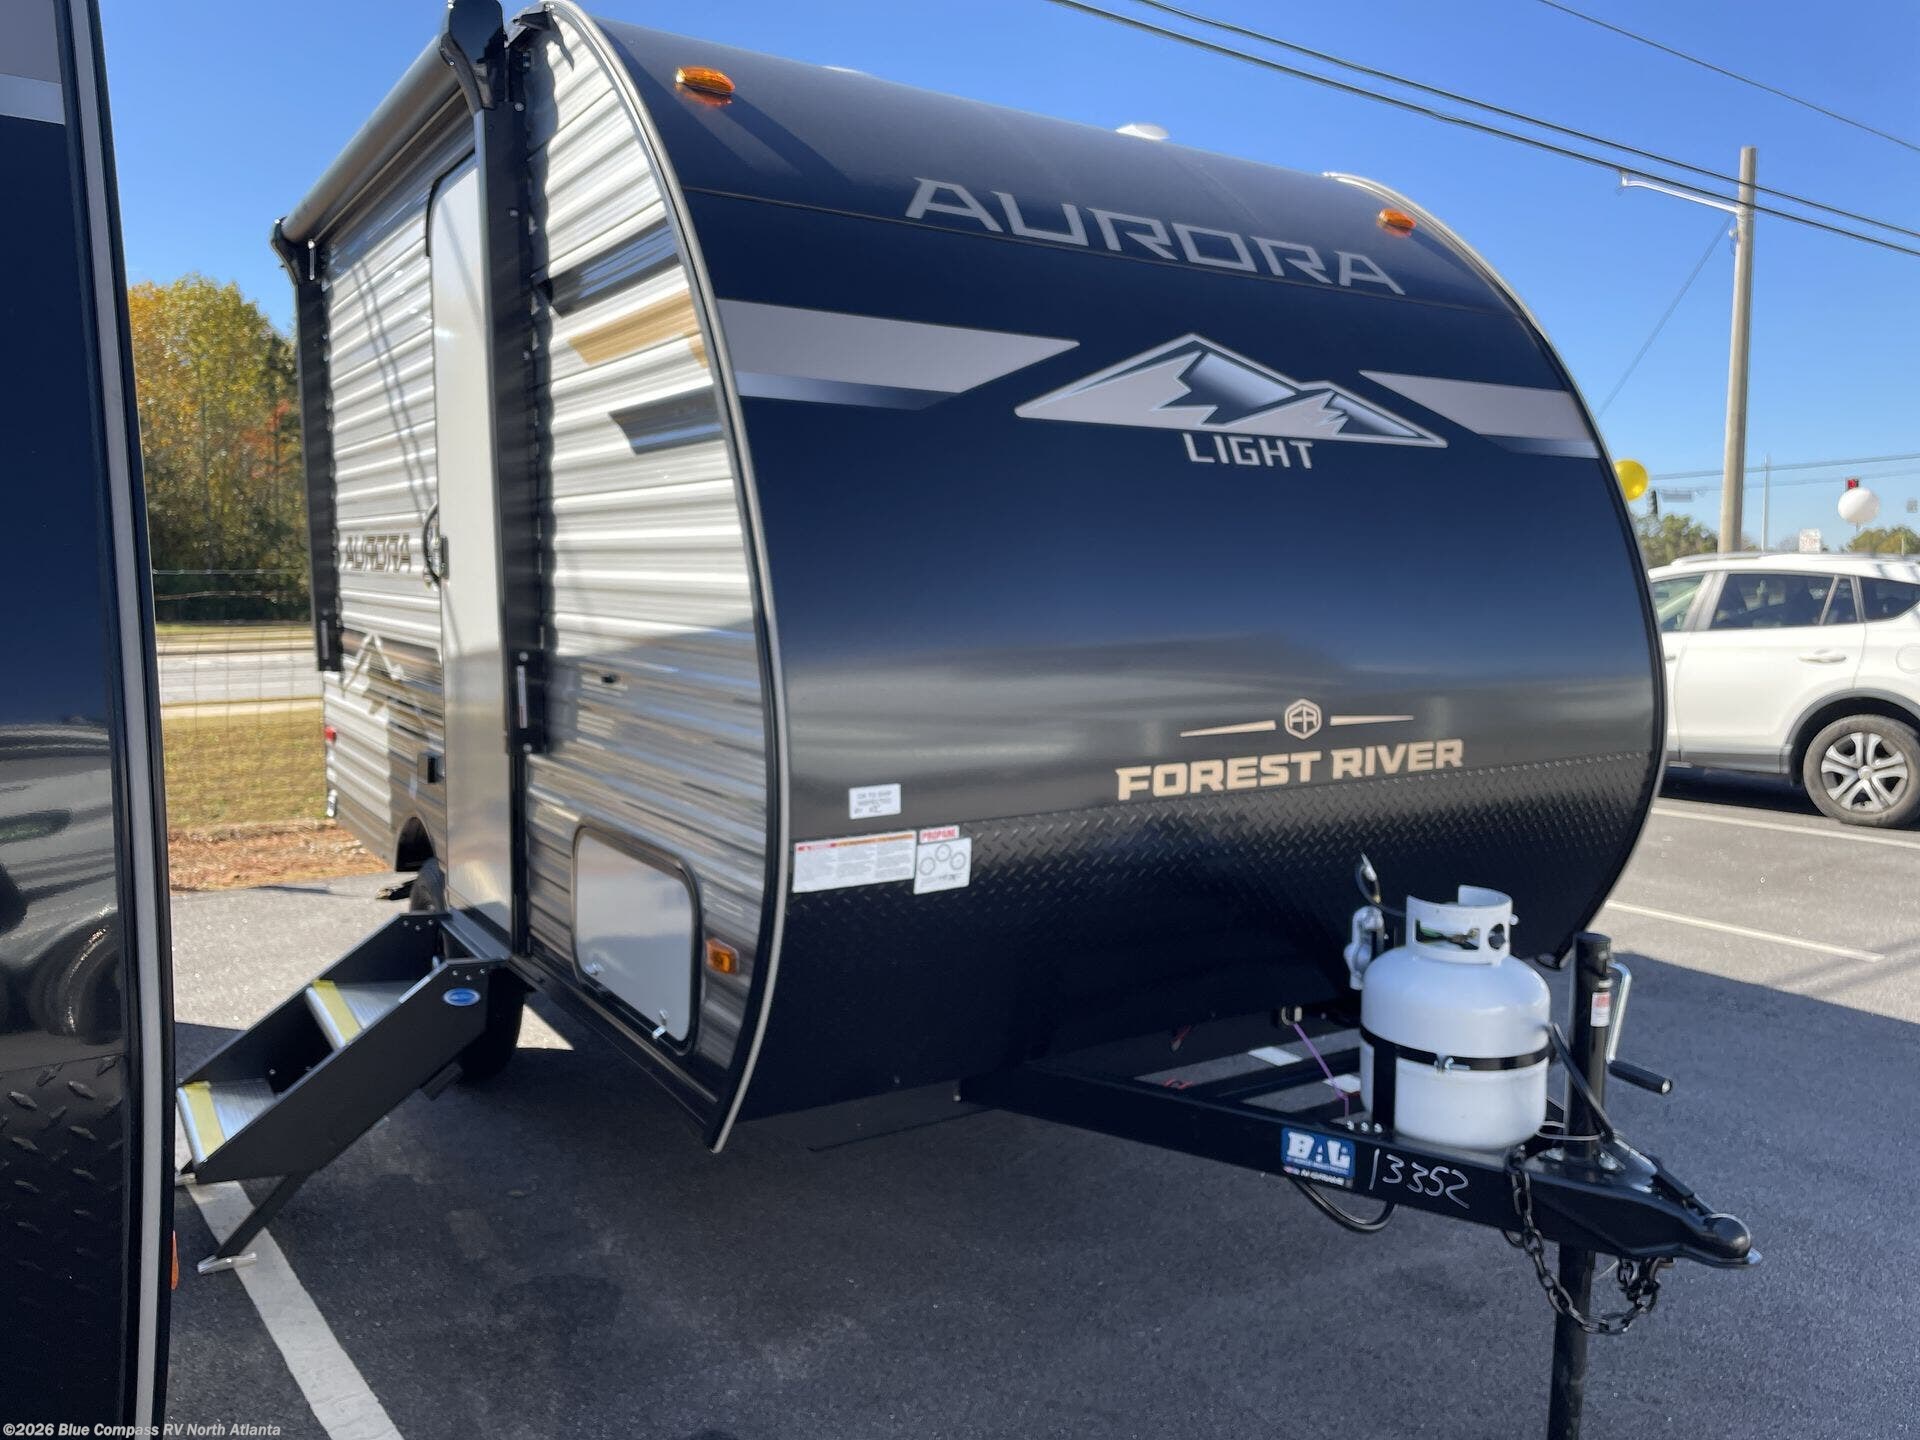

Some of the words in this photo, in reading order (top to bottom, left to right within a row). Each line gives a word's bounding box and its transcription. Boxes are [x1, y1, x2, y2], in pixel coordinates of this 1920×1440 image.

[904, 176, 1406, 296] AURORA
[1182, 432, 1314, 470] LIGHT
[346, 534, 411, 573] AURORA
[1115, 750, 1322, 801] FOREST
[1330, 738, 1465, 780] RIVER
[922, 828, 956, 840] PROPANE
[1368, 1148, 1470, 1210] 13352
